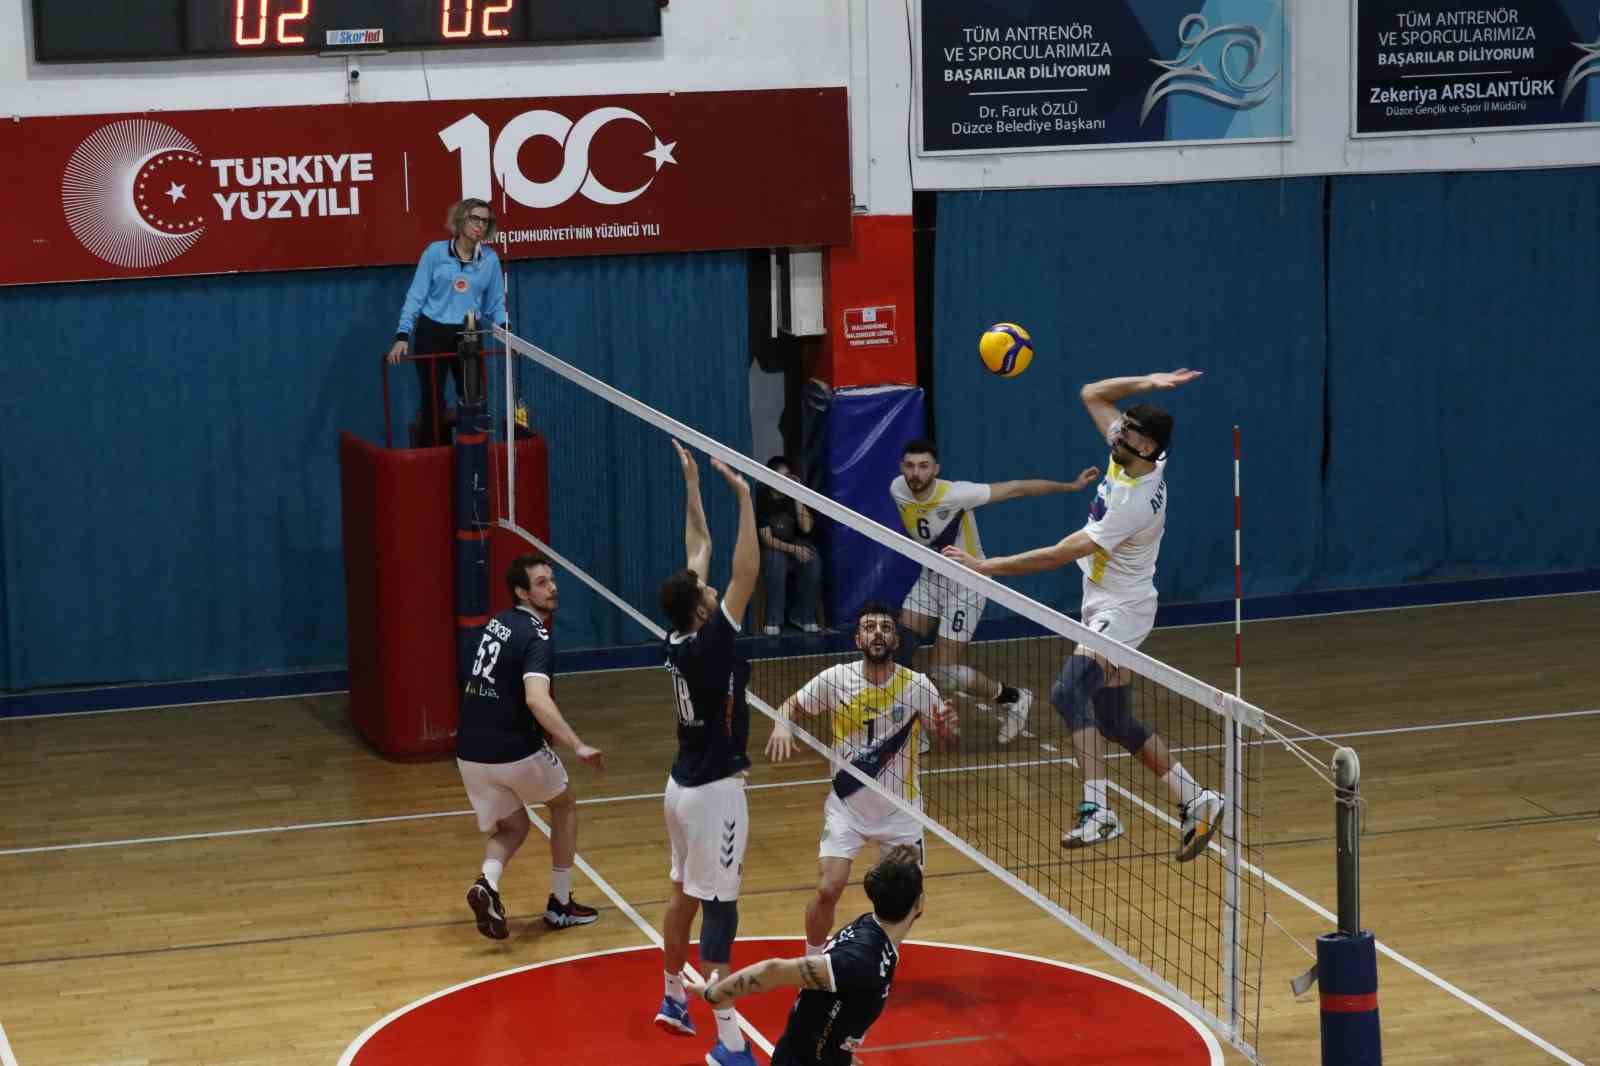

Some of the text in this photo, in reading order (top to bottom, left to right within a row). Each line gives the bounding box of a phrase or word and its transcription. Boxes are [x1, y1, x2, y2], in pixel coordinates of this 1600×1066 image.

[1396, 8, 1519, 28] TÜM ANTRENÖR
[963, 22, 1093, 43] TÜM ANTRENÖR
[1378, 26, 1536, 46] VE SPORCULARIMIZA
[944, 42, 1113, 62] VE SPORCULARIMIZA
[1378, 46, 1535, 67] BAŞARILAR DİLİYORUM
[944, 62, 1111, 84] BAŞARILAR DİLİYORUM
[1370, 77, 1555, 104] Zekeriya ARSLANTÜRK
[979, 101, 1078, 119] Dr. Faruk ÖZLÜ
[1449, 105, 1460, 113] ve
[1462, 103, 1481, 115] Spor
[951, 118, 1106, 135] Düzce Belediye Başkanı
[210, 153, 374, 187] TÜRKİYE
[212, 187, 360, 221] YÜZYILI
[508, 226, 592, 243] CUMHURİYETİ'NİN
[594, 222, 639, 239] YÜZÜNCÜ
[641, 223, 660, 237] YILI
[916, 518, 930, 540] 6
[952, 610, 965, 632] 6
[472, 634, 501, 684] 52
[863, 718, 875, 745] 1
